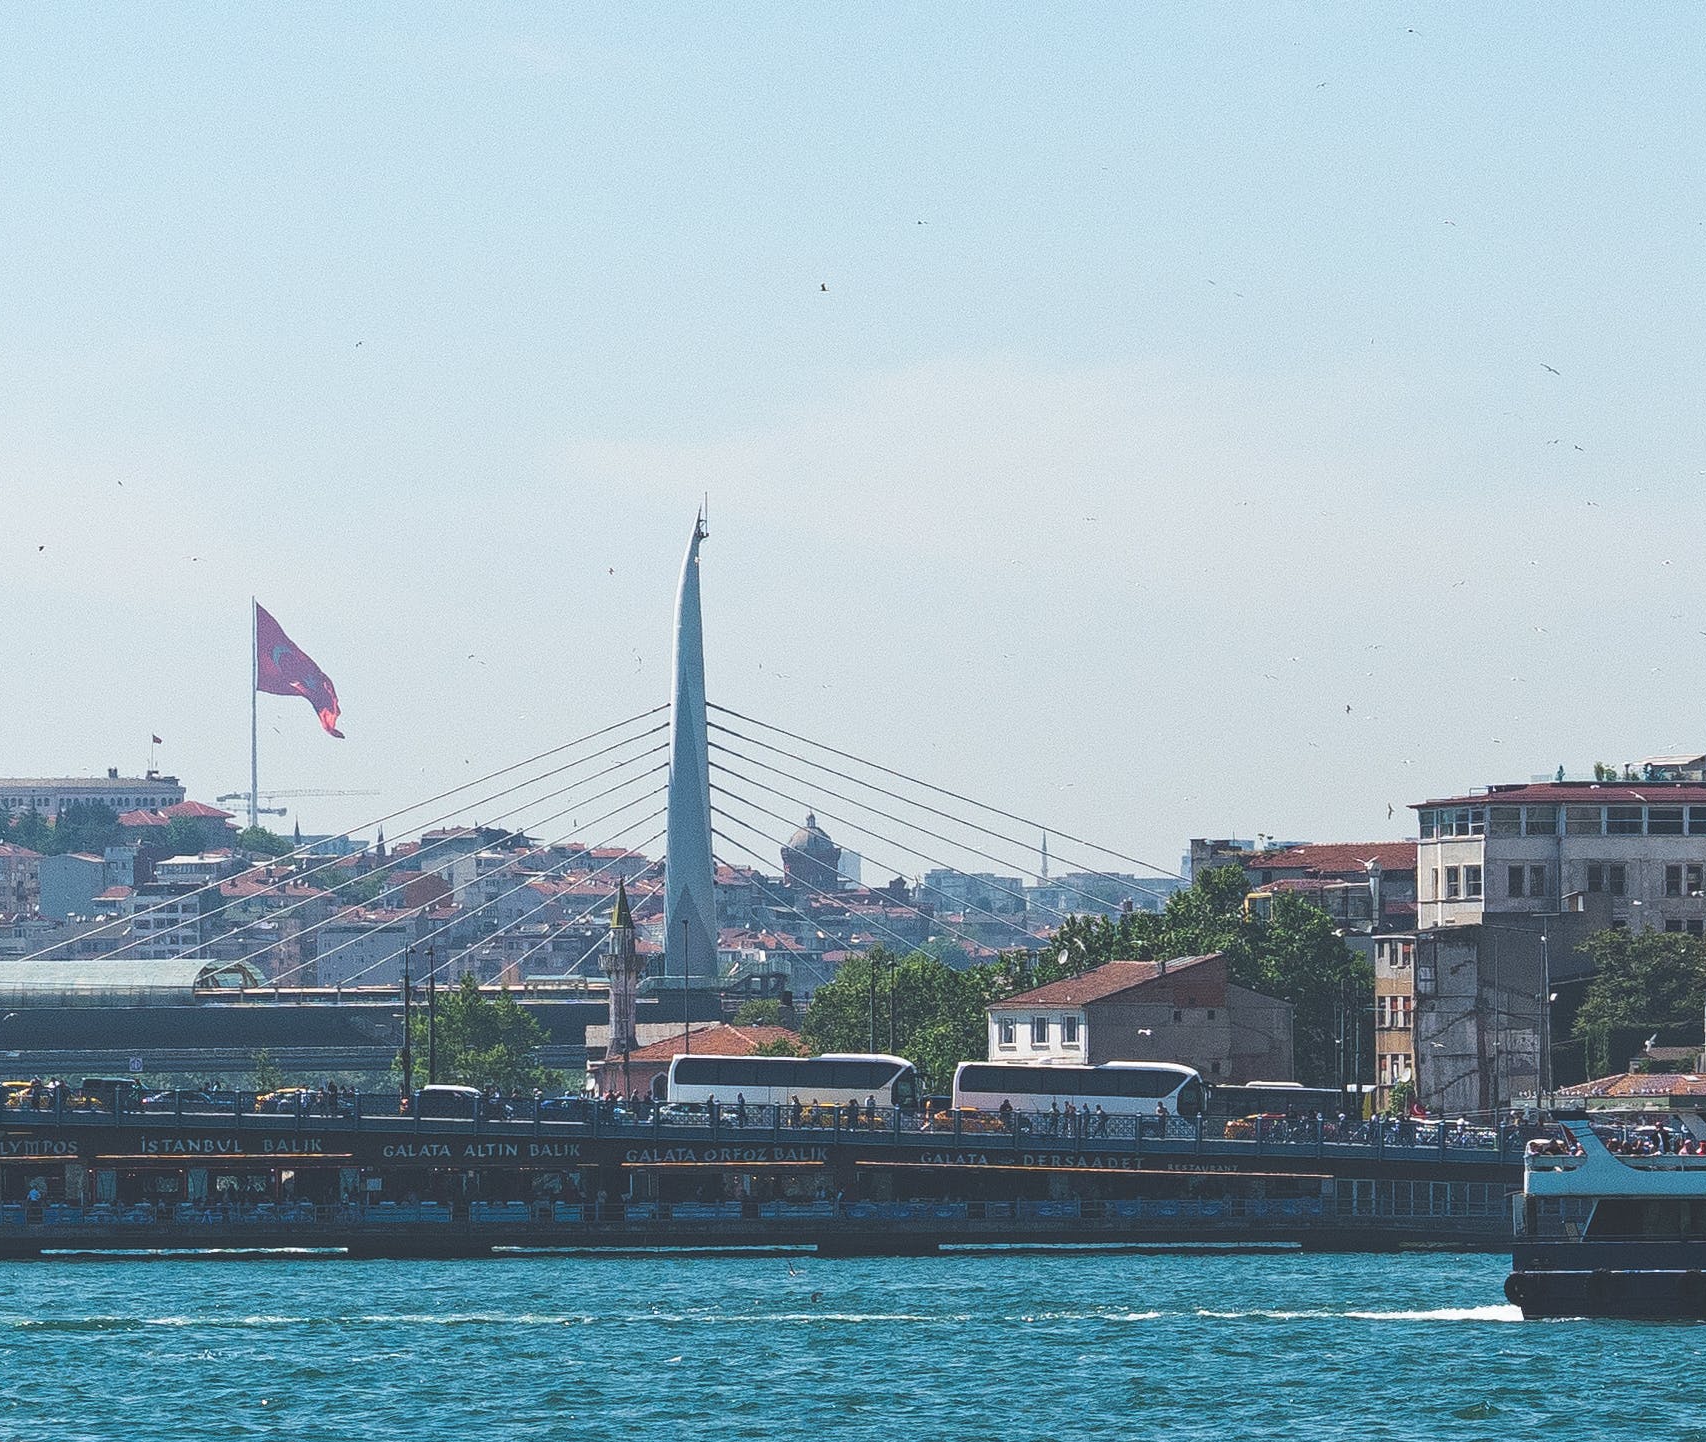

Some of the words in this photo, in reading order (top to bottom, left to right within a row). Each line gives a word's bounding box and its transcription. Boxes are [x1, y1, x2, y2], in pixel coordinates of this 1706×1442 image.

[140, 1135, 243, 1153] İSTANBUL
[262, 1138, 323, 1153] BALIK
[382, 1143, 451, 1158] GALATA
[463, 1143, 519, 1157] ALTIN
[529, 1142, 581, 1157] BALIK
[625, 1147, 696, 1162] GALATA
[703, 1147, 767, 1162] ORFOZ
[773, 1146, 828, 1161] BALIK
[920, 1152, 988, 1165] GALATA
[1022, 1153, 1145, 1169] DERSAADET
